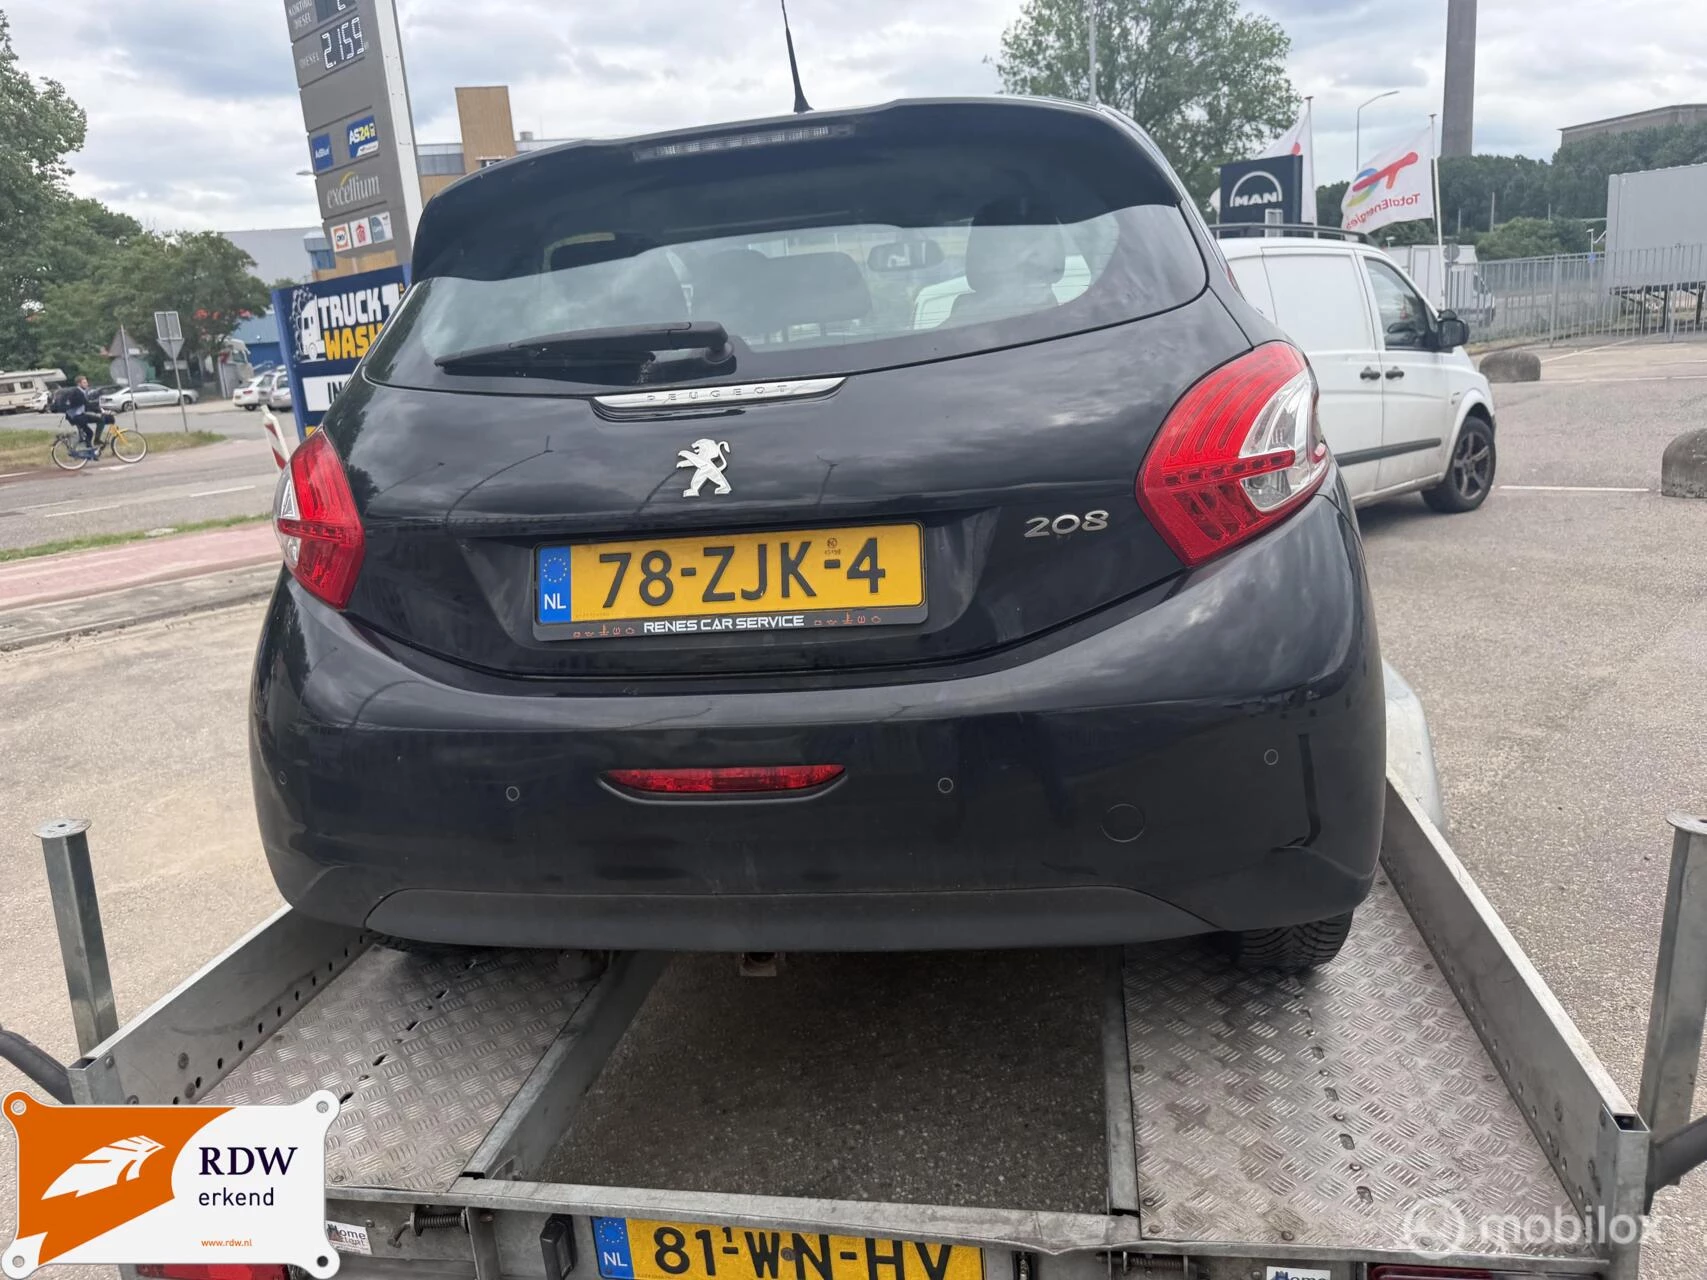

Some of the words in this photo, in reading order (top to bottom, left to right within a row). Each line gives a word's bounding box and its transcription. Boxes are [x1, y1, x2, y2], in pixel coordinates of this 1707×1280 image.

[327, 175, 380, 209] excellium
[1234, 191, 1278, 207] MAN
[317, 287, 383, 329] TRUCK
[647, 384, 788, 401] PEUGEOT
[1023, 510, 1109, 538] 208
[600, 536, 886, 609] 78-ZJK-4
[544, 592, 567, 610] NL
[643, 620, 698, 634] RENES
[700, 618, 734, 631] CAR
[735, 615, 805, 630] SERVICE
[603, 1251, 628, 1267] NL
